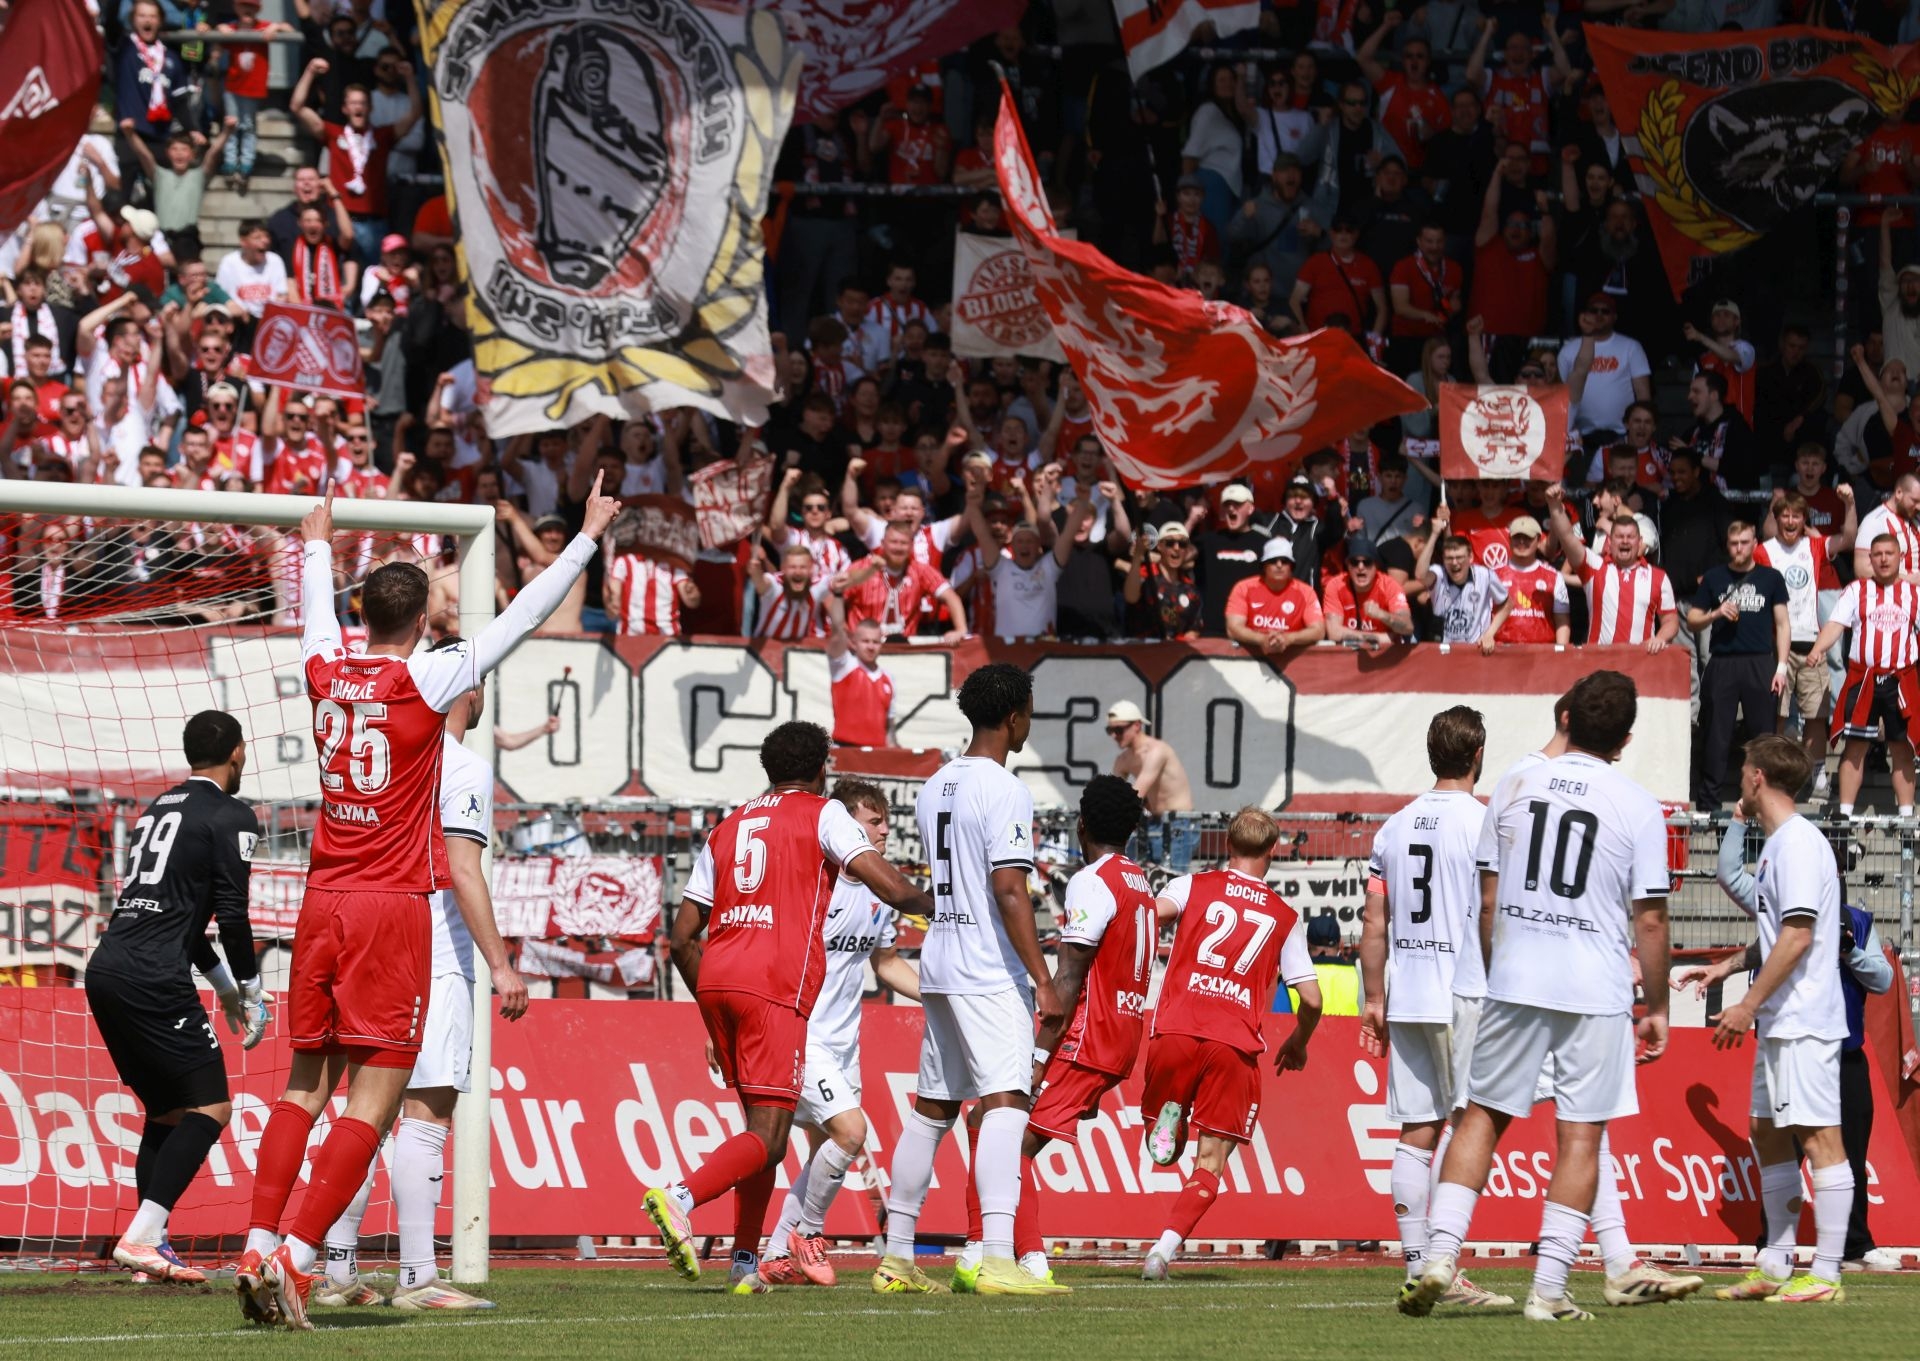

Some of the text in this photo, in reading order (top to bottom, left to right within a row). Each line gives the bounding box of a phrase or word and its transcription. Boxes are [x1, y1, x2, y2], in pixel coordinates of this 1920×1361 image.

[1253, 615, 1290, 631] OKAL
[1347, 618, 1375, 632] OAL
[330, 679, 377, 700] DAHLKE
[315, 700, 391, 795] 25
[1548, 778, 1589, 796] DACAJ
[1414, 817, 1440, 830] GALLE
[123, 811, 183, 889] 39
[733, 816, 771, 894] 5
[936, 811, 953, 897] 5
[1523, 800, 1600, 900] 10
[1225, 883, 1268, 906] BOCHE
[1408, 843, 1434, 924] 3
[1499, 902, 1601, 933] HOLZAPFEL
[1197, 900, 1277, 976] 27
[1188, 972, 1251, 1006] POLYMA
[818, 1078, 834, 1103] 6
[0, 1068, 143, 1188] Das
